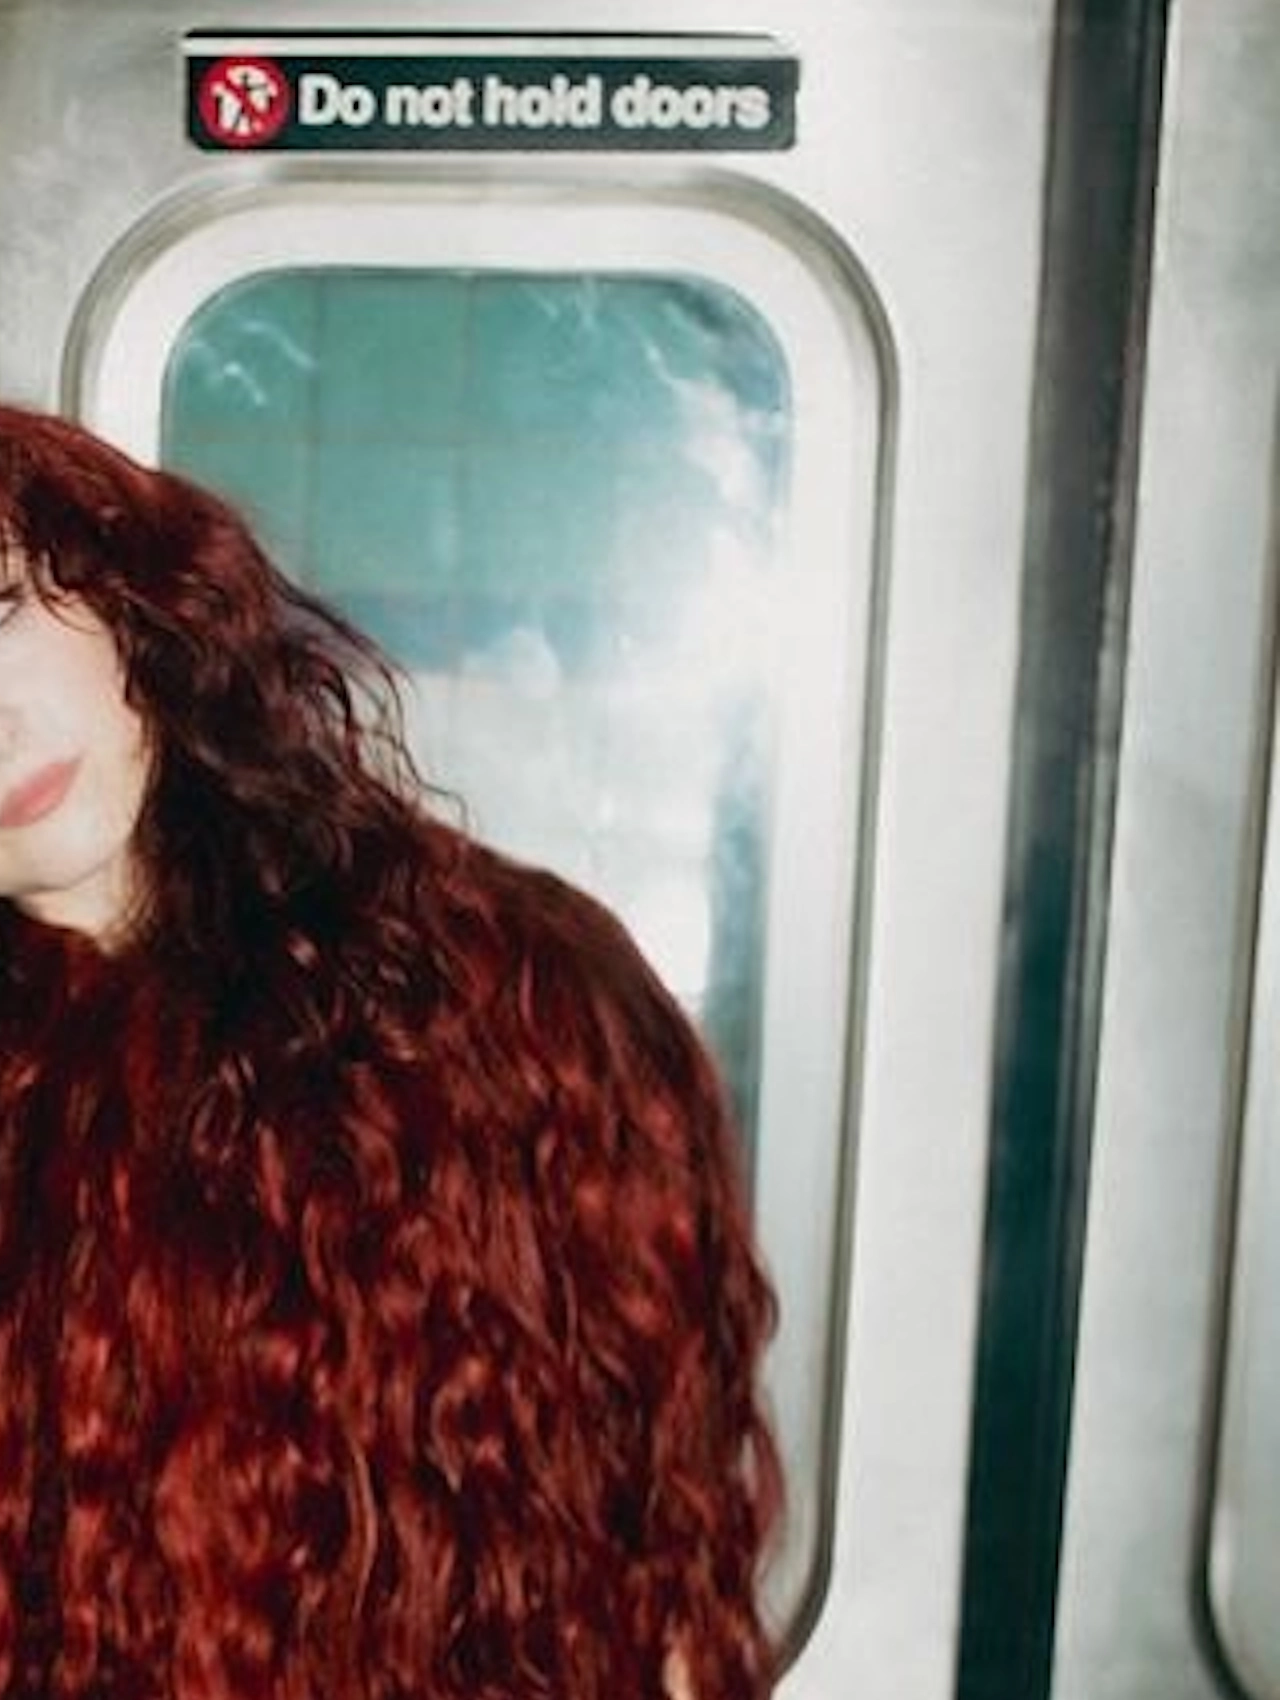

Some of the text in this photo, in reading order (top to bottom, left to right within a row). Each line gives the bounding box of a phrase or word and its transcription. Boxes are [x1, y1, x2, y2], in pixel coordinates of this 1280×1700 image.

[298, 74, 771, 129] Do not hold doors
